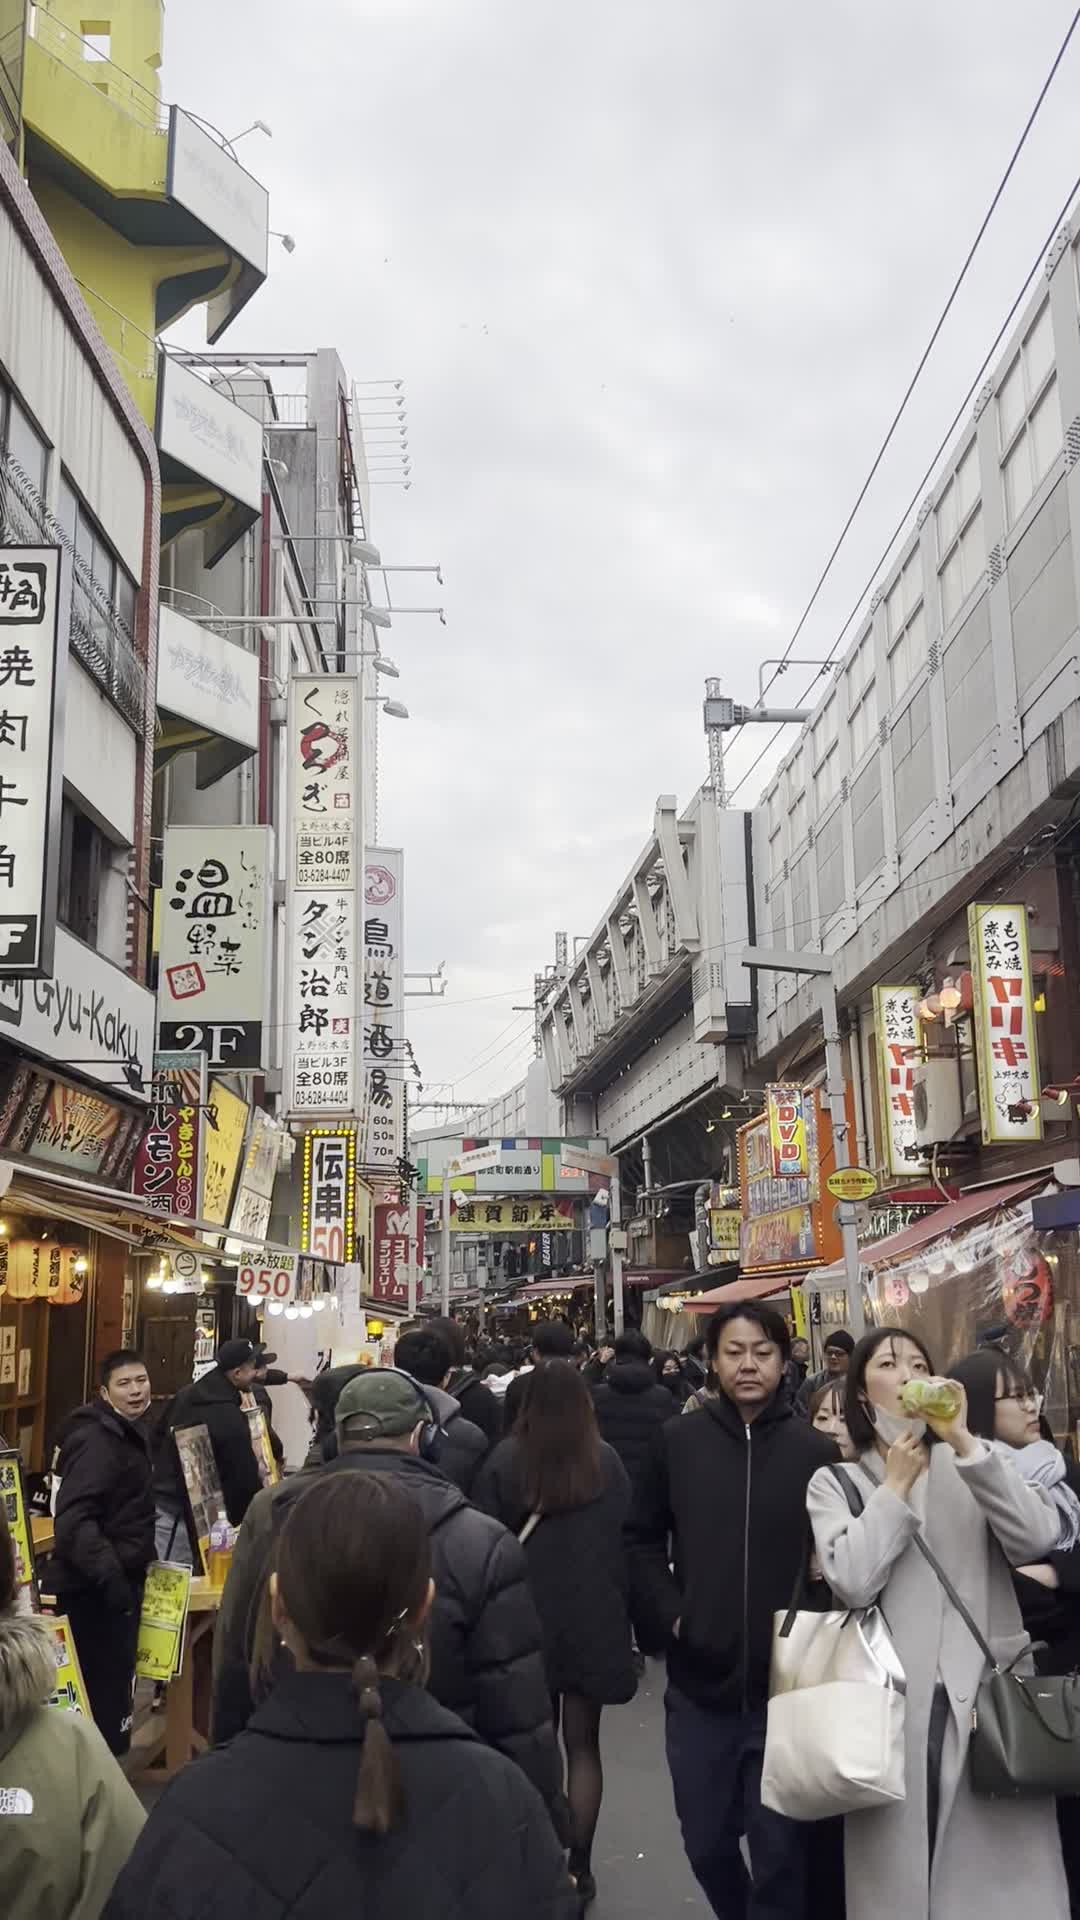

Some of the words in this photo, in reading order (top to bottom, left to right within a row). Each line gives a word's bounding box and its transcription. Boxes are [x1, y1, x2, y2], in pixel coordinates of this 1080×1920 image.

[299, 850, 350, 865] 全80席
[300, 836, 350, 848] 当ビル4F
[298, 867, 351, 883] 03-6284-4407
[984, 920, 1002, 970] 煮込み
[1003, 921, 1022, 971] もつ焼
[33, 978, 138, 1062] Gyu-Kaku
[901, 999, 916, 1040] もつ焼
[987, 975, 1028, 1067] ヤリキ
[175, 1024, 247, 1064] 2F
[296, 1071, 349, 1087] 全80席
[297, 1056, 348, 1069] 当ビル3F
[295, 1089, 348, 1105] 03-6284-4404
[174, 1106, 194, 1177] やきとん
[776, 1105, 801, 1161] DVD
[315, 1142, 344, 1224] 伝串
[457, 1204, 554, 1223] 謹賀新年
[240, 1251, 295, 1271] 飲み放題
[239, 1268, 290, 1297] 950
